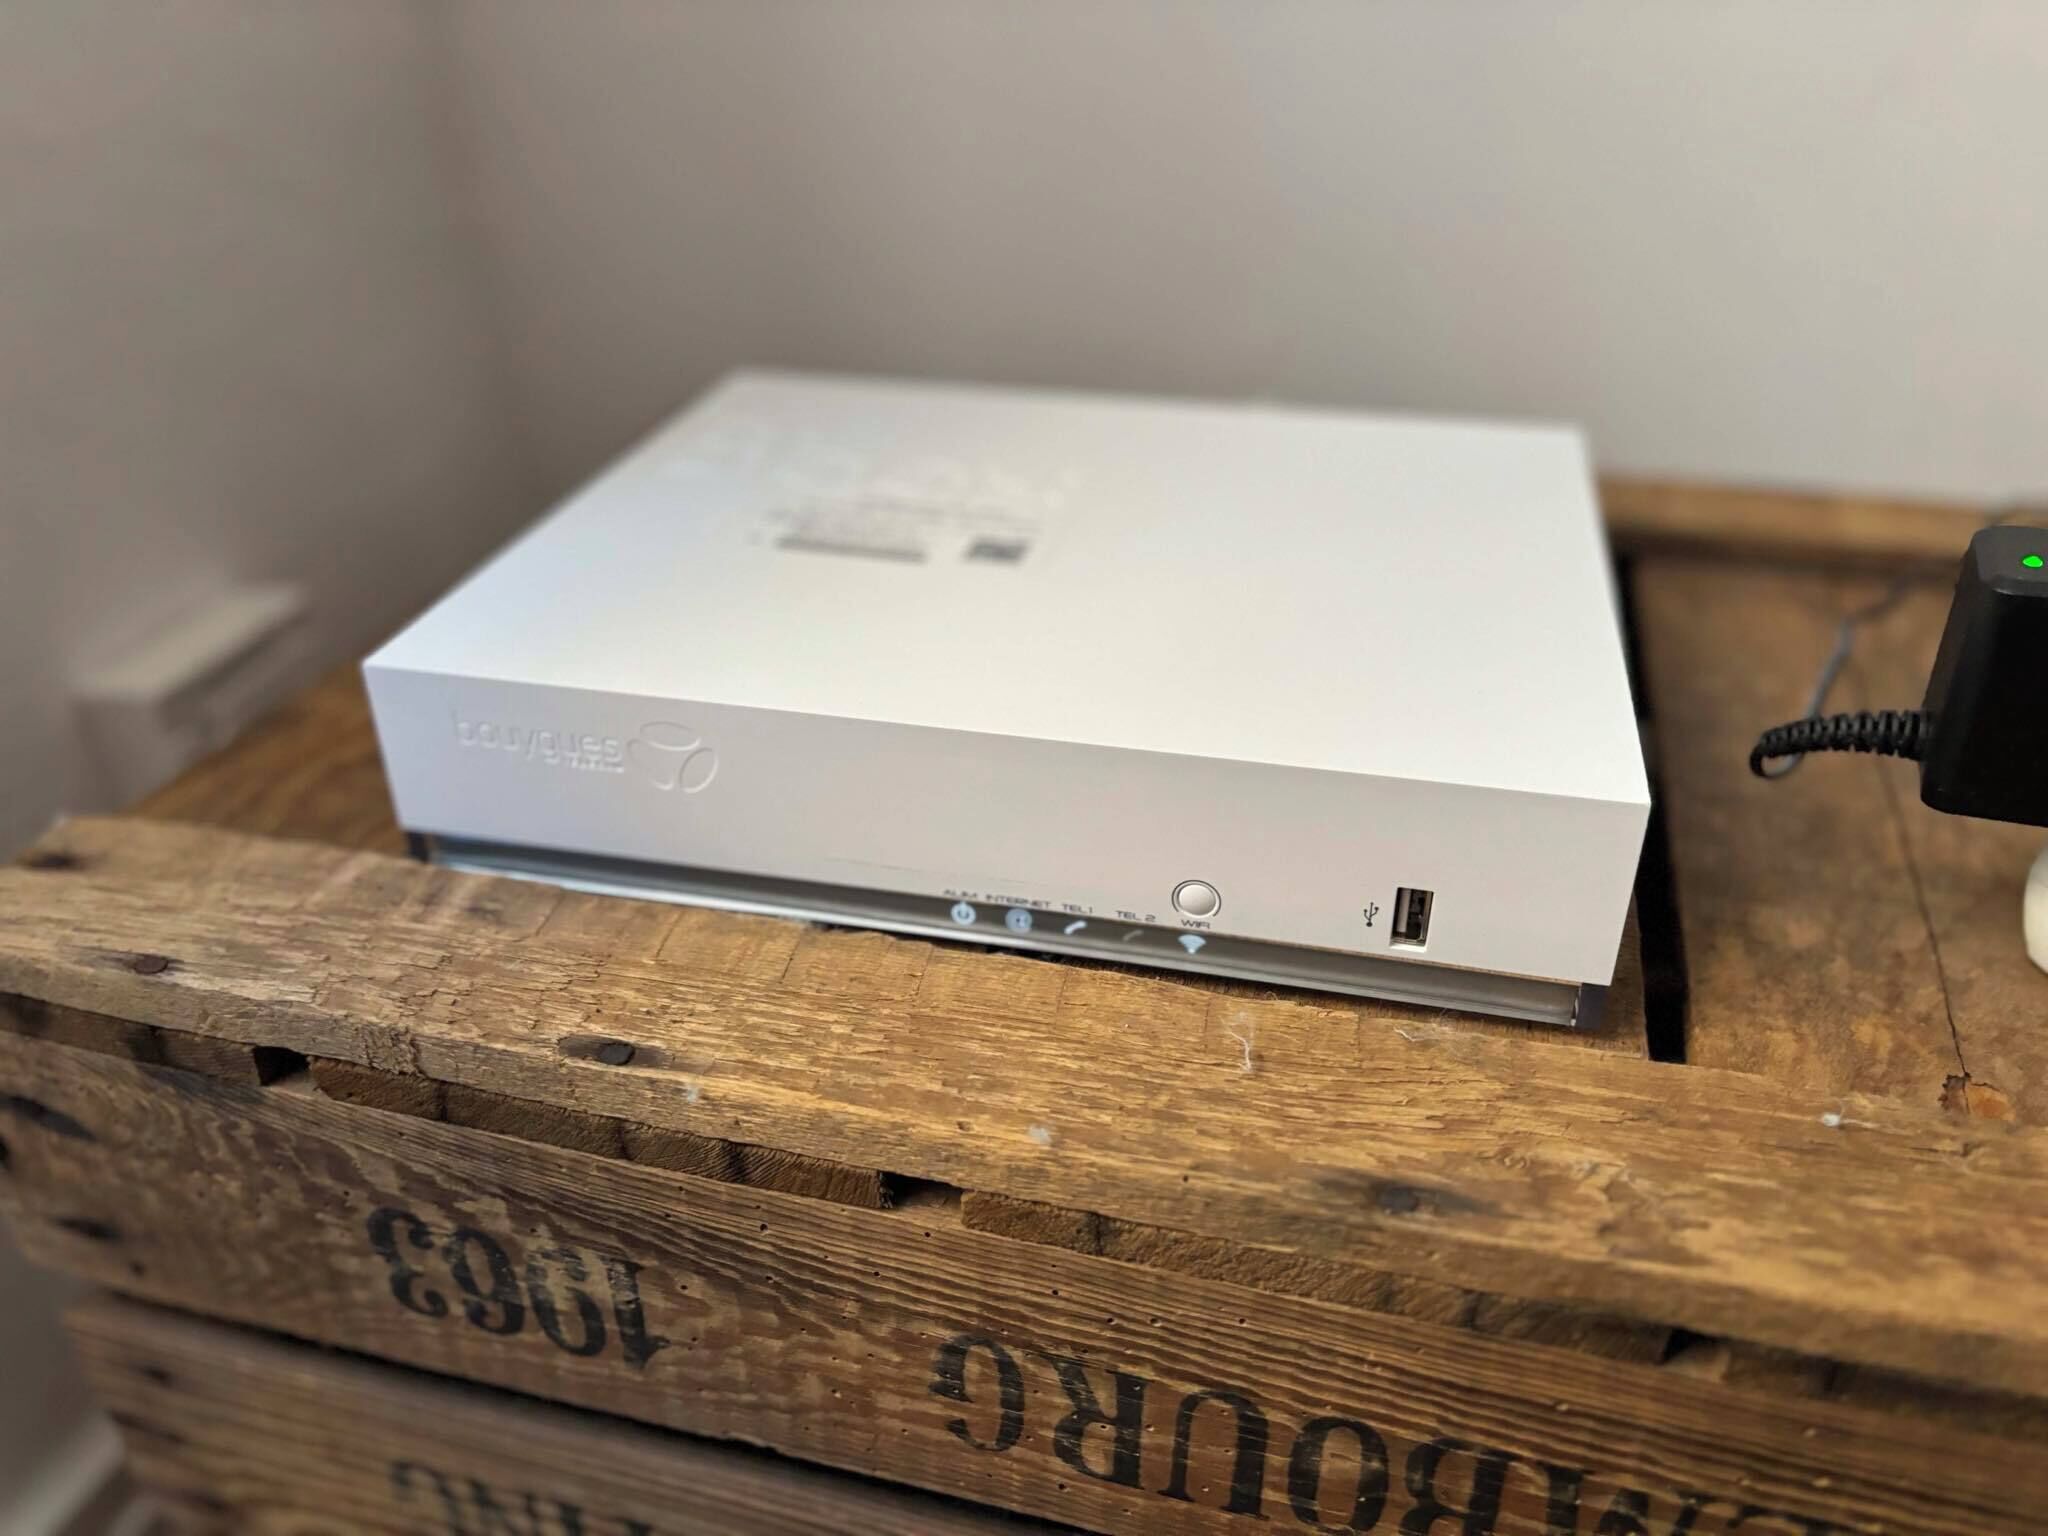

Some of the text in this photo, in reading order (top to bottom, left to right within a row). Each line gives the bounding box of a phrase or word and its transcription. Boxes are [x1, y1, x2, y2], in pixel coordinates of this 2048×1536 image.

[985, 893, 1052, 909] INTERNET
[1115, 910, 1142, 921] TEL
[366, 1206, 672, 1370] 1963
